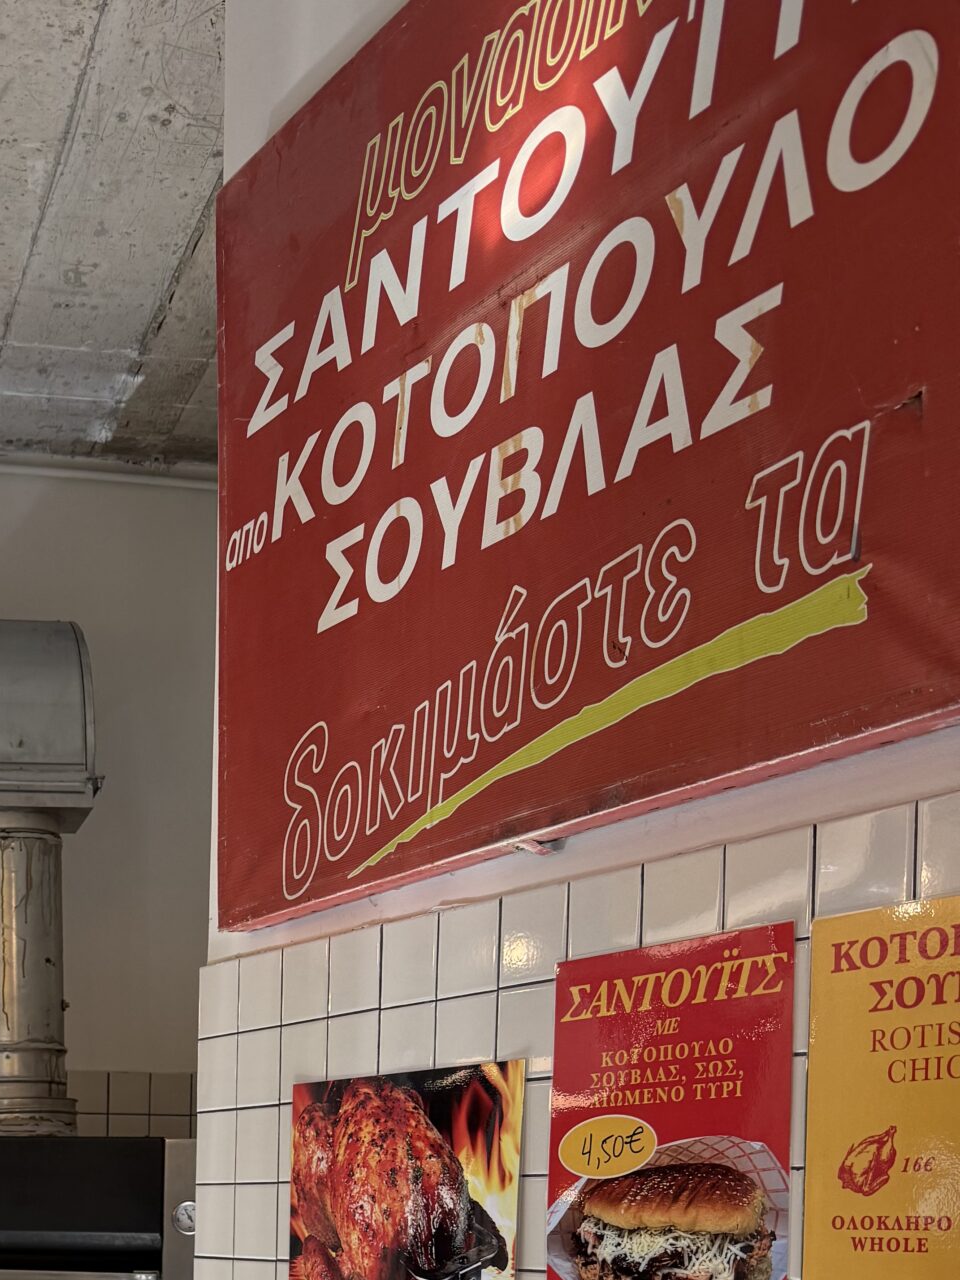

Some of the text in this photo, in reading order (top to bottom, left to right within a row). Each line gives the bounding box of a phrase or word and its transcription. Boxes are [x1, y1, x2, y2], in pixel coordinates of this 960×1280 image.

[225, 29, 939, 572] απο ΚΟΤΟΠΟΥΛΟ
[317, 283, 783, 633] ΣΟΥΒΛΑΣ
[283, 421, 871, 899] δοκιμάστε τα
[559, 949, 788, 1023] ΣΑΝΤΟΥΪΤΣ
[868, 970, 960, 1013] ΣΟΥ
[653, 1016, 680, 1036] ΜΕ
[600, 1037, 733, 1067] ΚΟΤΟΠΟΥΛΟ
[590, 1058, 744, 1089] ΣΟΥΒΛΑΣ, ΣΩΣ,
[590, 1080, 743, 1108] ΛΙΩΜΕΝΟ ΤΥΡΙ
[581, 1126, 645, 1169] 4,50€
[831, 1215, 952, 1232] ΟΛΟΚΛΗΡΟ
[850, 1237, 929, 1253] WHOLE
